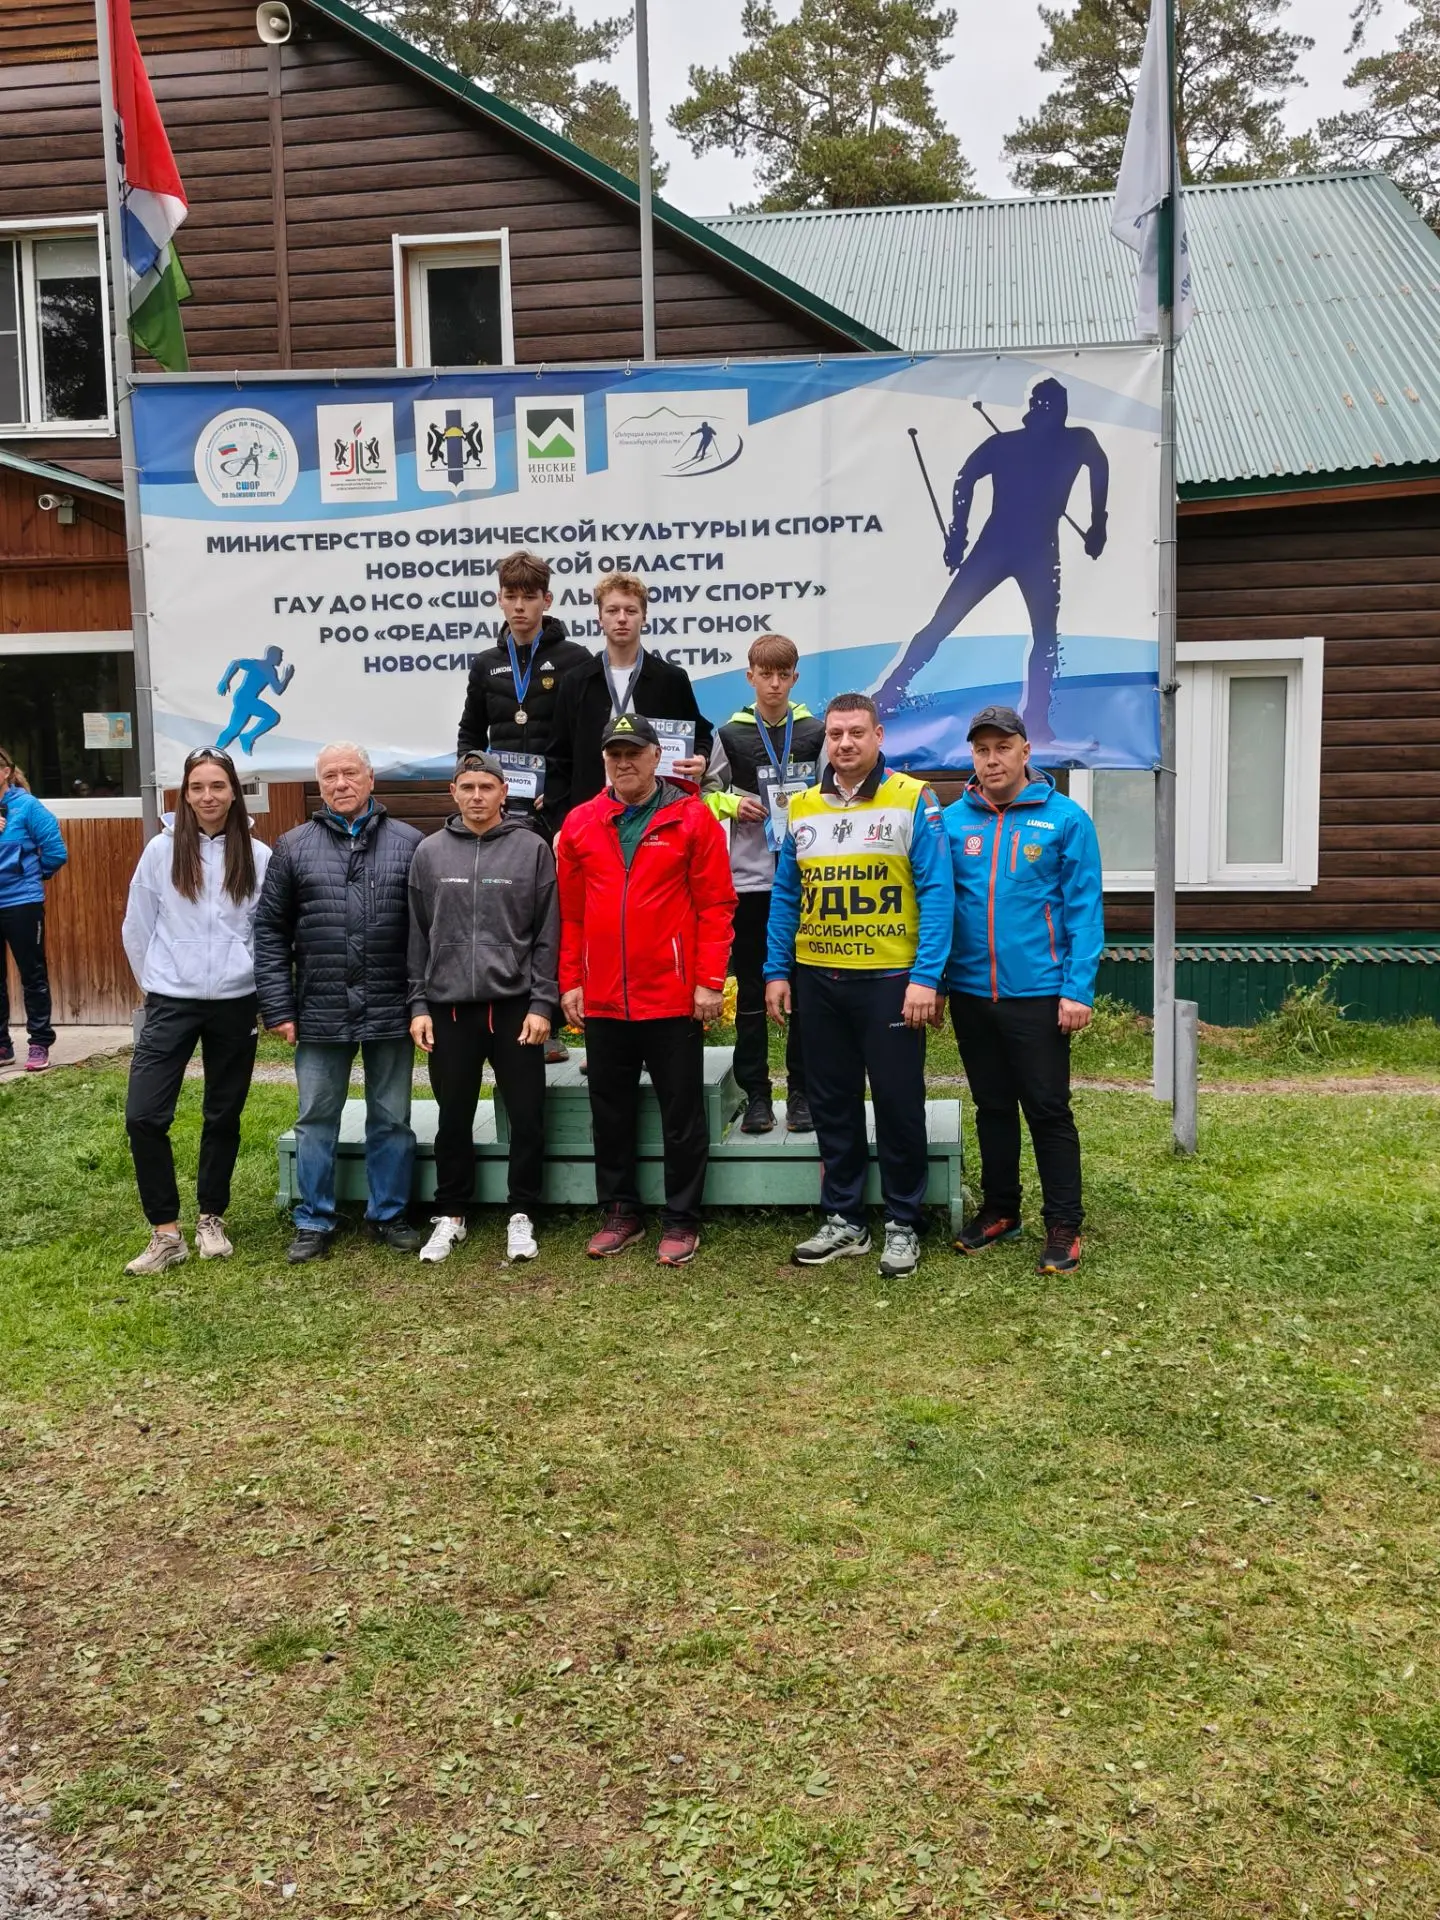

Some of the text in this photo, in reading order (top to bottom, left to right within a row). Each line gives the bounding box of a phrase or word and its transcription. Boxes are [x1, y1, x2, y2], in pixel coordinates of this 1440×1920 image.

[528, 463, 577, 473] ИНСКИЕ
[236, 481, 261, 490] СШОР
[531, 473, 575, 484] ХОЛМЫ
[207, 515, 883, 553] МИНИСТЕРСТВО ФИЗИЧЕСКОЙ КУЛЬТУРЫ И СПОРТА
[598, 553, 724, 573] ОБЛАСТИ
[274, 596, 324, 614] ГАУ
[330, 594, 366, 614] ДО
[372, 592, 423, 611] НСО
[705, 580, 827, 602] СПОРТУ»
[320, 625, 369, 644] РОО
[683, 614, 772, 634] ГОНОК
[1026, 819, 1055, 830] LUKOIL
[801, 861, 889, 881] ЛАВНЫЙ
[809, 941, 875, 956] ОБЛАСТЬ
